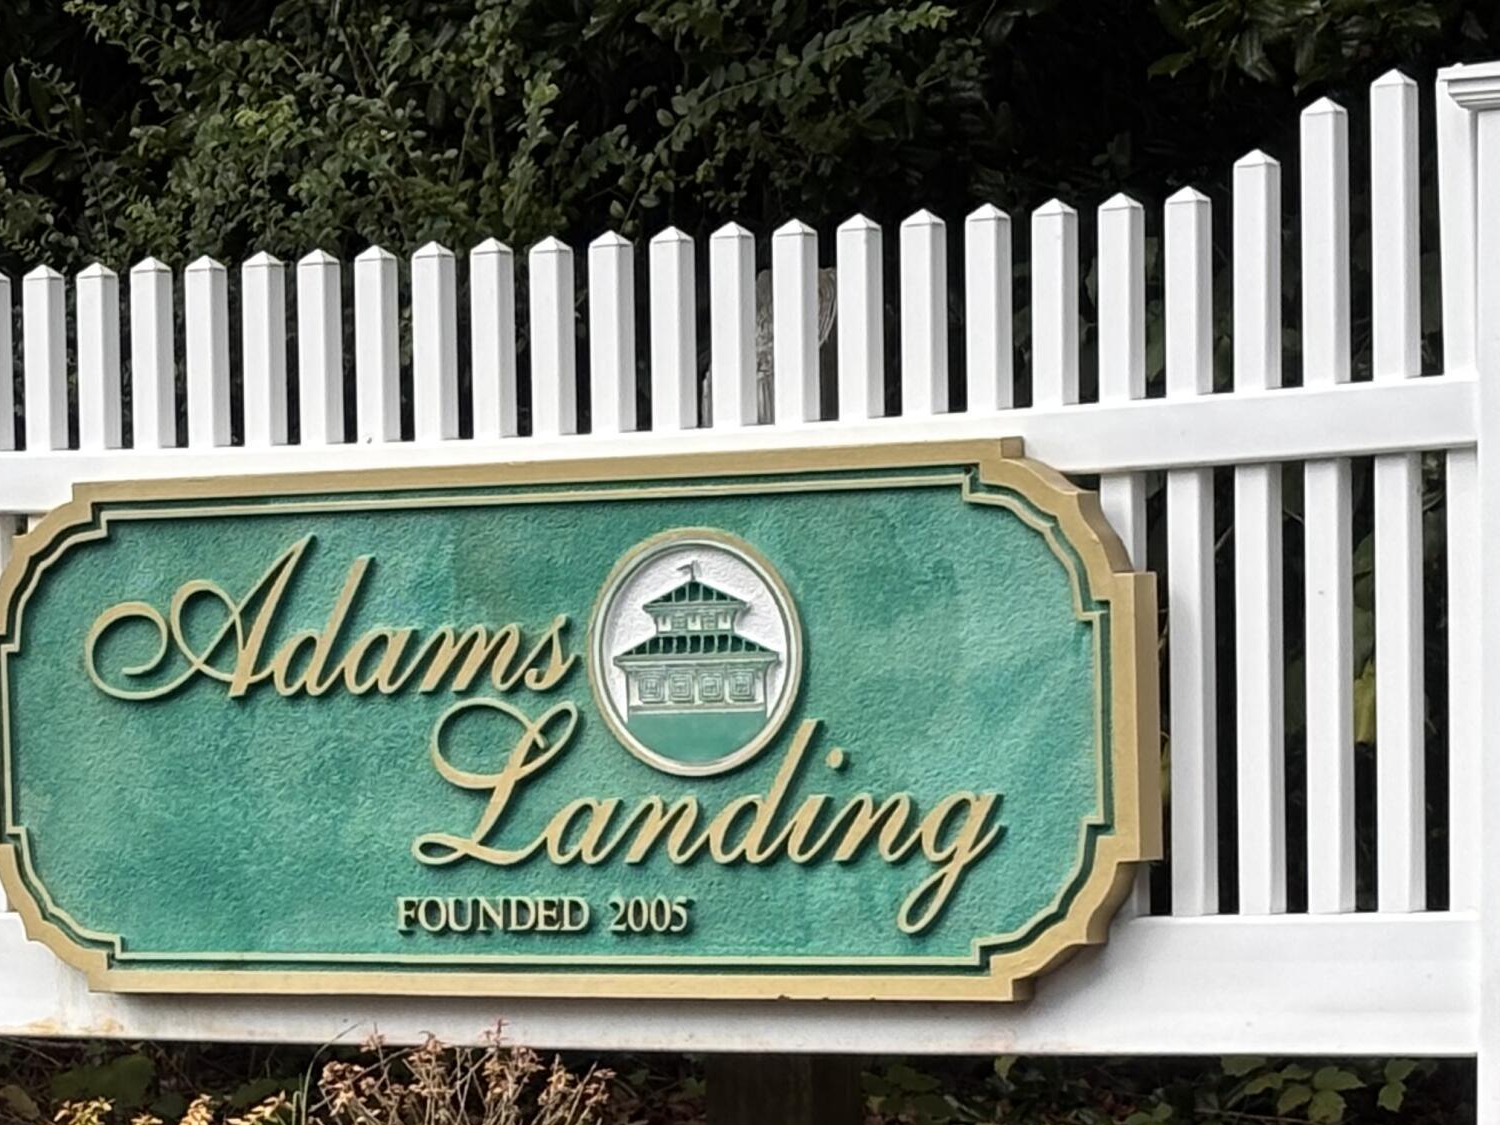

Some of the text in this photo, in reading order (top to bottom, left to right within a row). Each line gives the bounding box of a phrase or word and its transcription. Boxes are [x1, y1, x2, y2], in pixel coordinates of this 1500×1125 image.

[87, 532, 576, 699] Adams
[414, 699, 1003, 936] Landing
[397, 896, 689, 933] FOUNDED 2005
